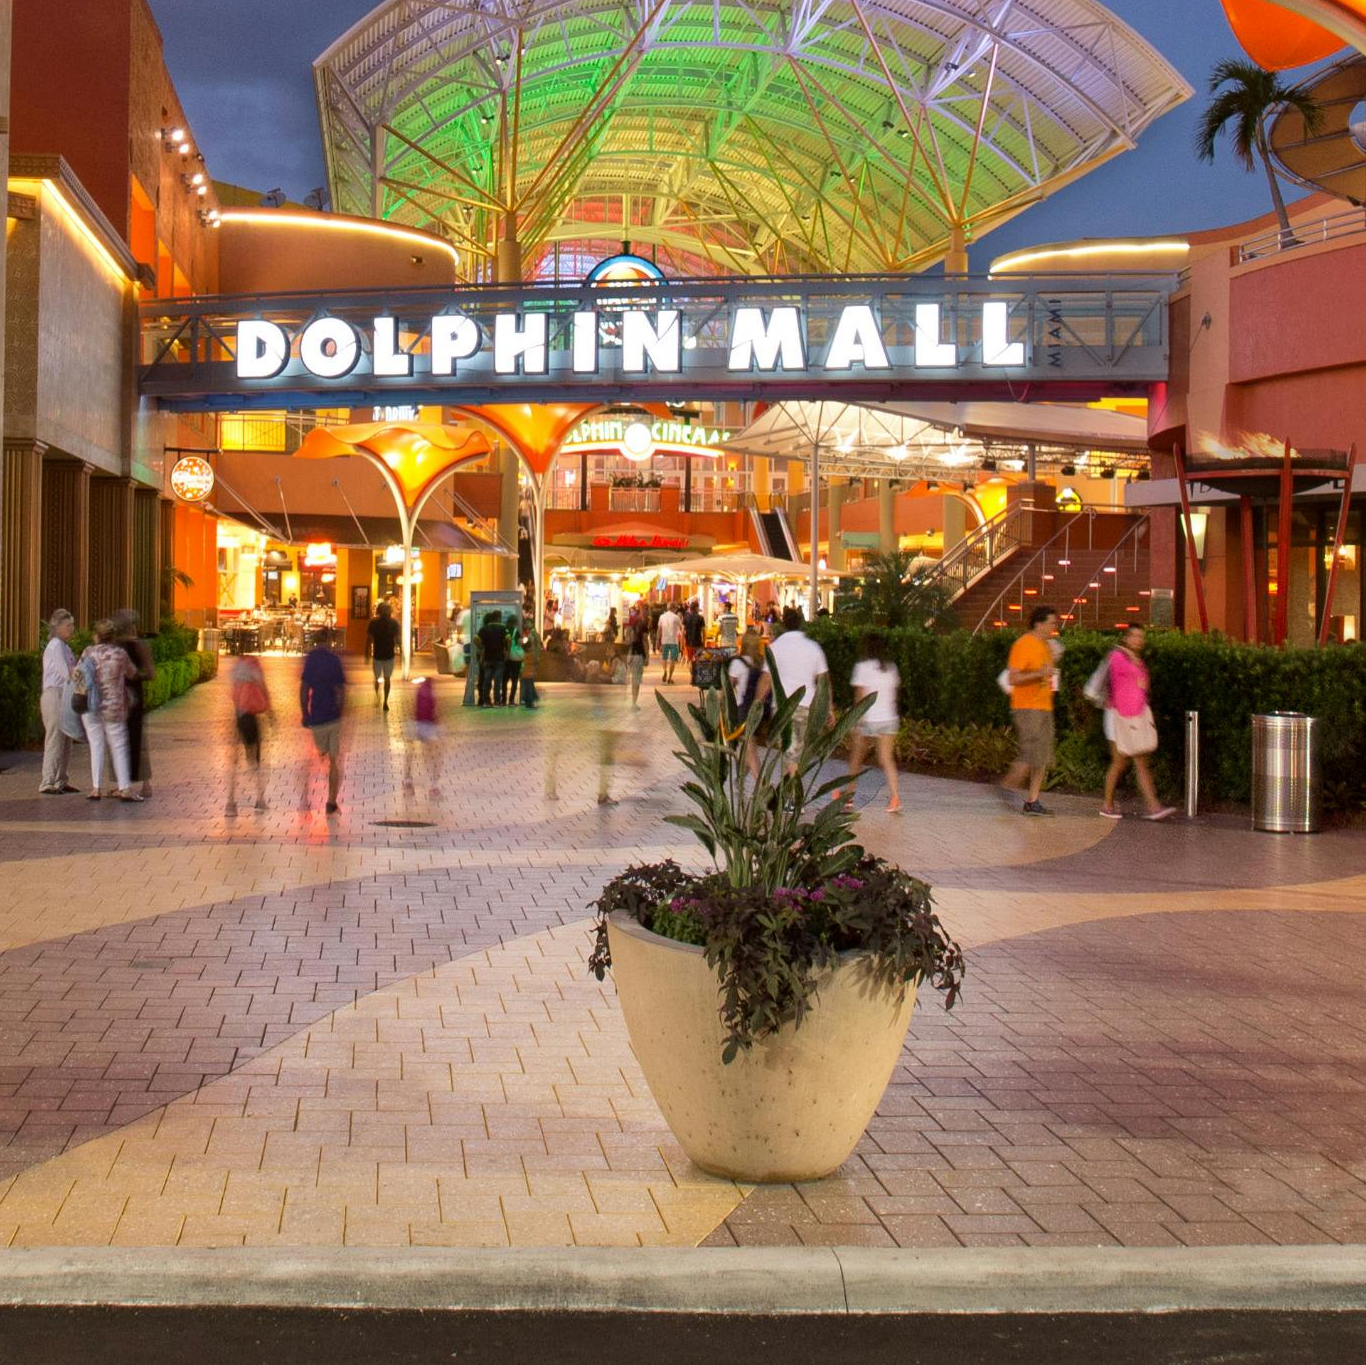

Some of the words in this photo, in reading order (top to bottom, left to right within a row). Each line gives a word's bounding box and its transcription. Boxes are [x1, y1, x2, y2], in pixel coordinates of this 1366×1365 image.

[236, 309, 682, 379] DOLPHIN
[727, 301, 1026, 372] MALL
[1048, 299, 1062, 367] MIAMI
[566, 419, 622, 443] LPHIN
